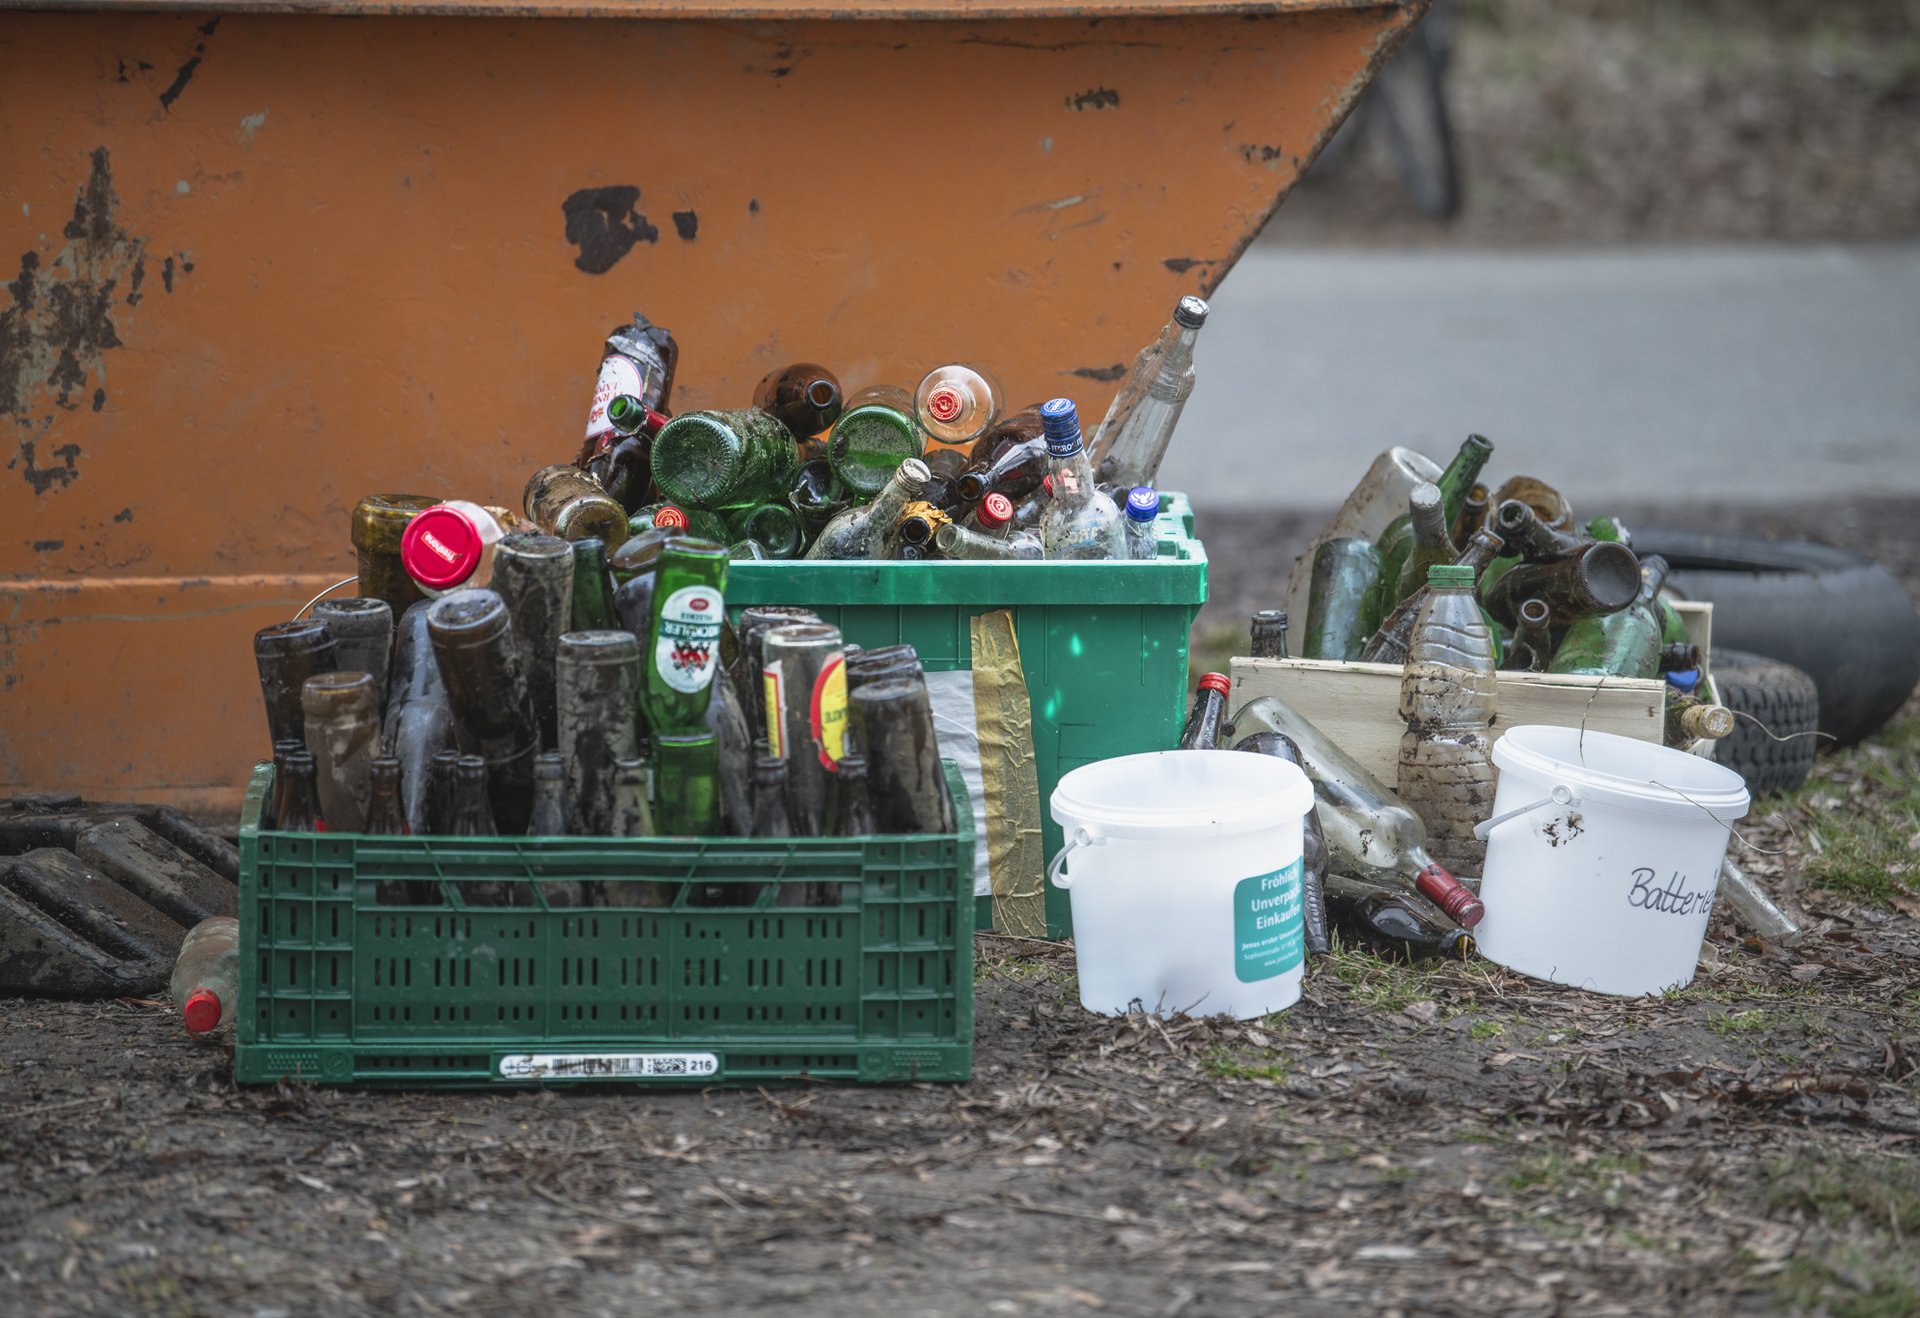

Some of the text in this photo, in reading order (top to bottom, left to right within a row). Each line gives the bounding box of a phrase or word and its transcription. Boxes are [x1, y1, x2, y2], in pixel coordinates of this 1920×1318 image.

[1261, 867, 1298, 891] Fröhlich
[1256, 903, 1301, 930] Einkaufen
[690, 1060, 712, 1071] 216
